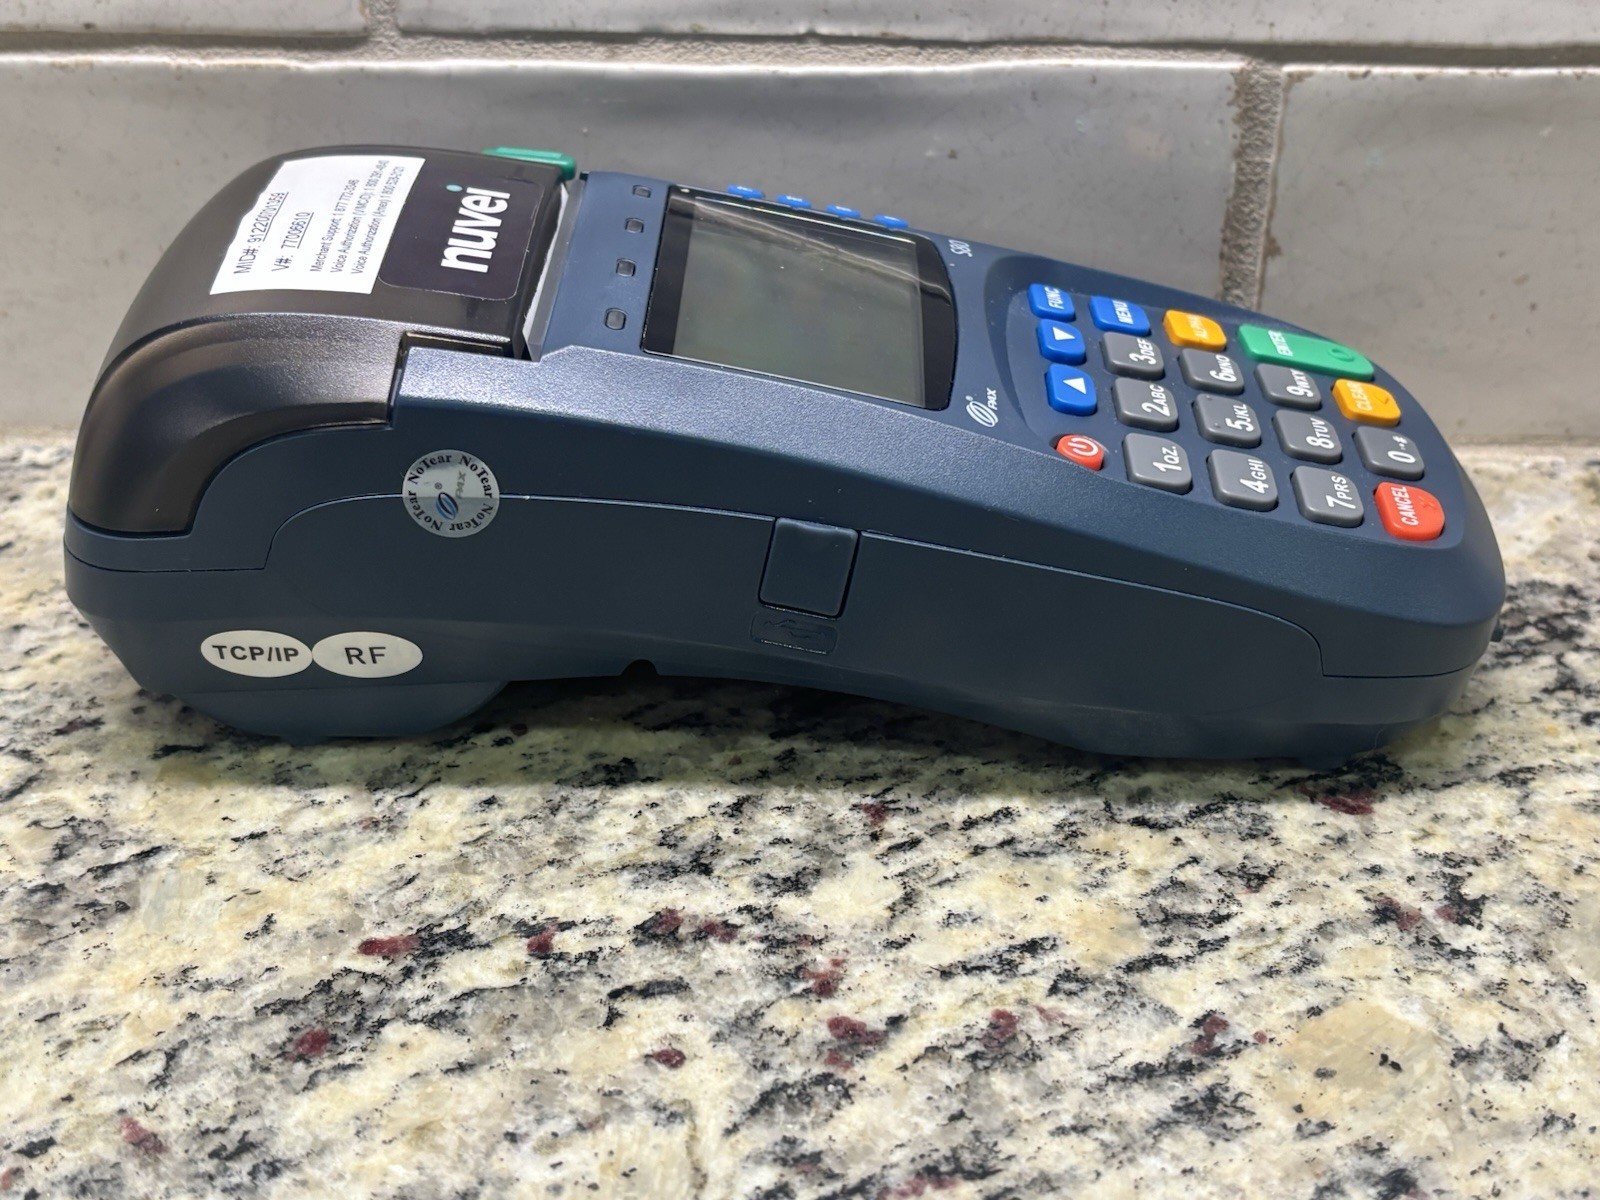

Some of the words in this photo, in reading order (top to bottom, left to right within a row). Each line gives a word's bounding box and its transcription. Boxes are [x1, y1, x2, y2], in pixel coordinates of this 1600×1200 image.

[338, 216, 362, 254] Authorization
[358, 217, 382, 256] Authorization
[441, 184, 511, 273] nuvei
[233, 246, 261, 274] MID#:
[271, 255, 294, 272] V#:
[309, 242, 331, 272] Merchant
[330, 254, 347, 273] Voice
[351, 254, 368, 274] Voice
[1044, 286, 1064, 310] FUNC
[1112, 300, 1134, 324] MENU
[408, 454, 452, 485] NoTear
[459, 454, 493, 499] NoTear
[408, 490, 443, 531] NoTear
[449, 503, 494, 531] NoTear
[1391, 486, 1419, 526] CANCEL
[212, 645, 299, 662] TCP/IP
[345, 647, 386, 665] RF
